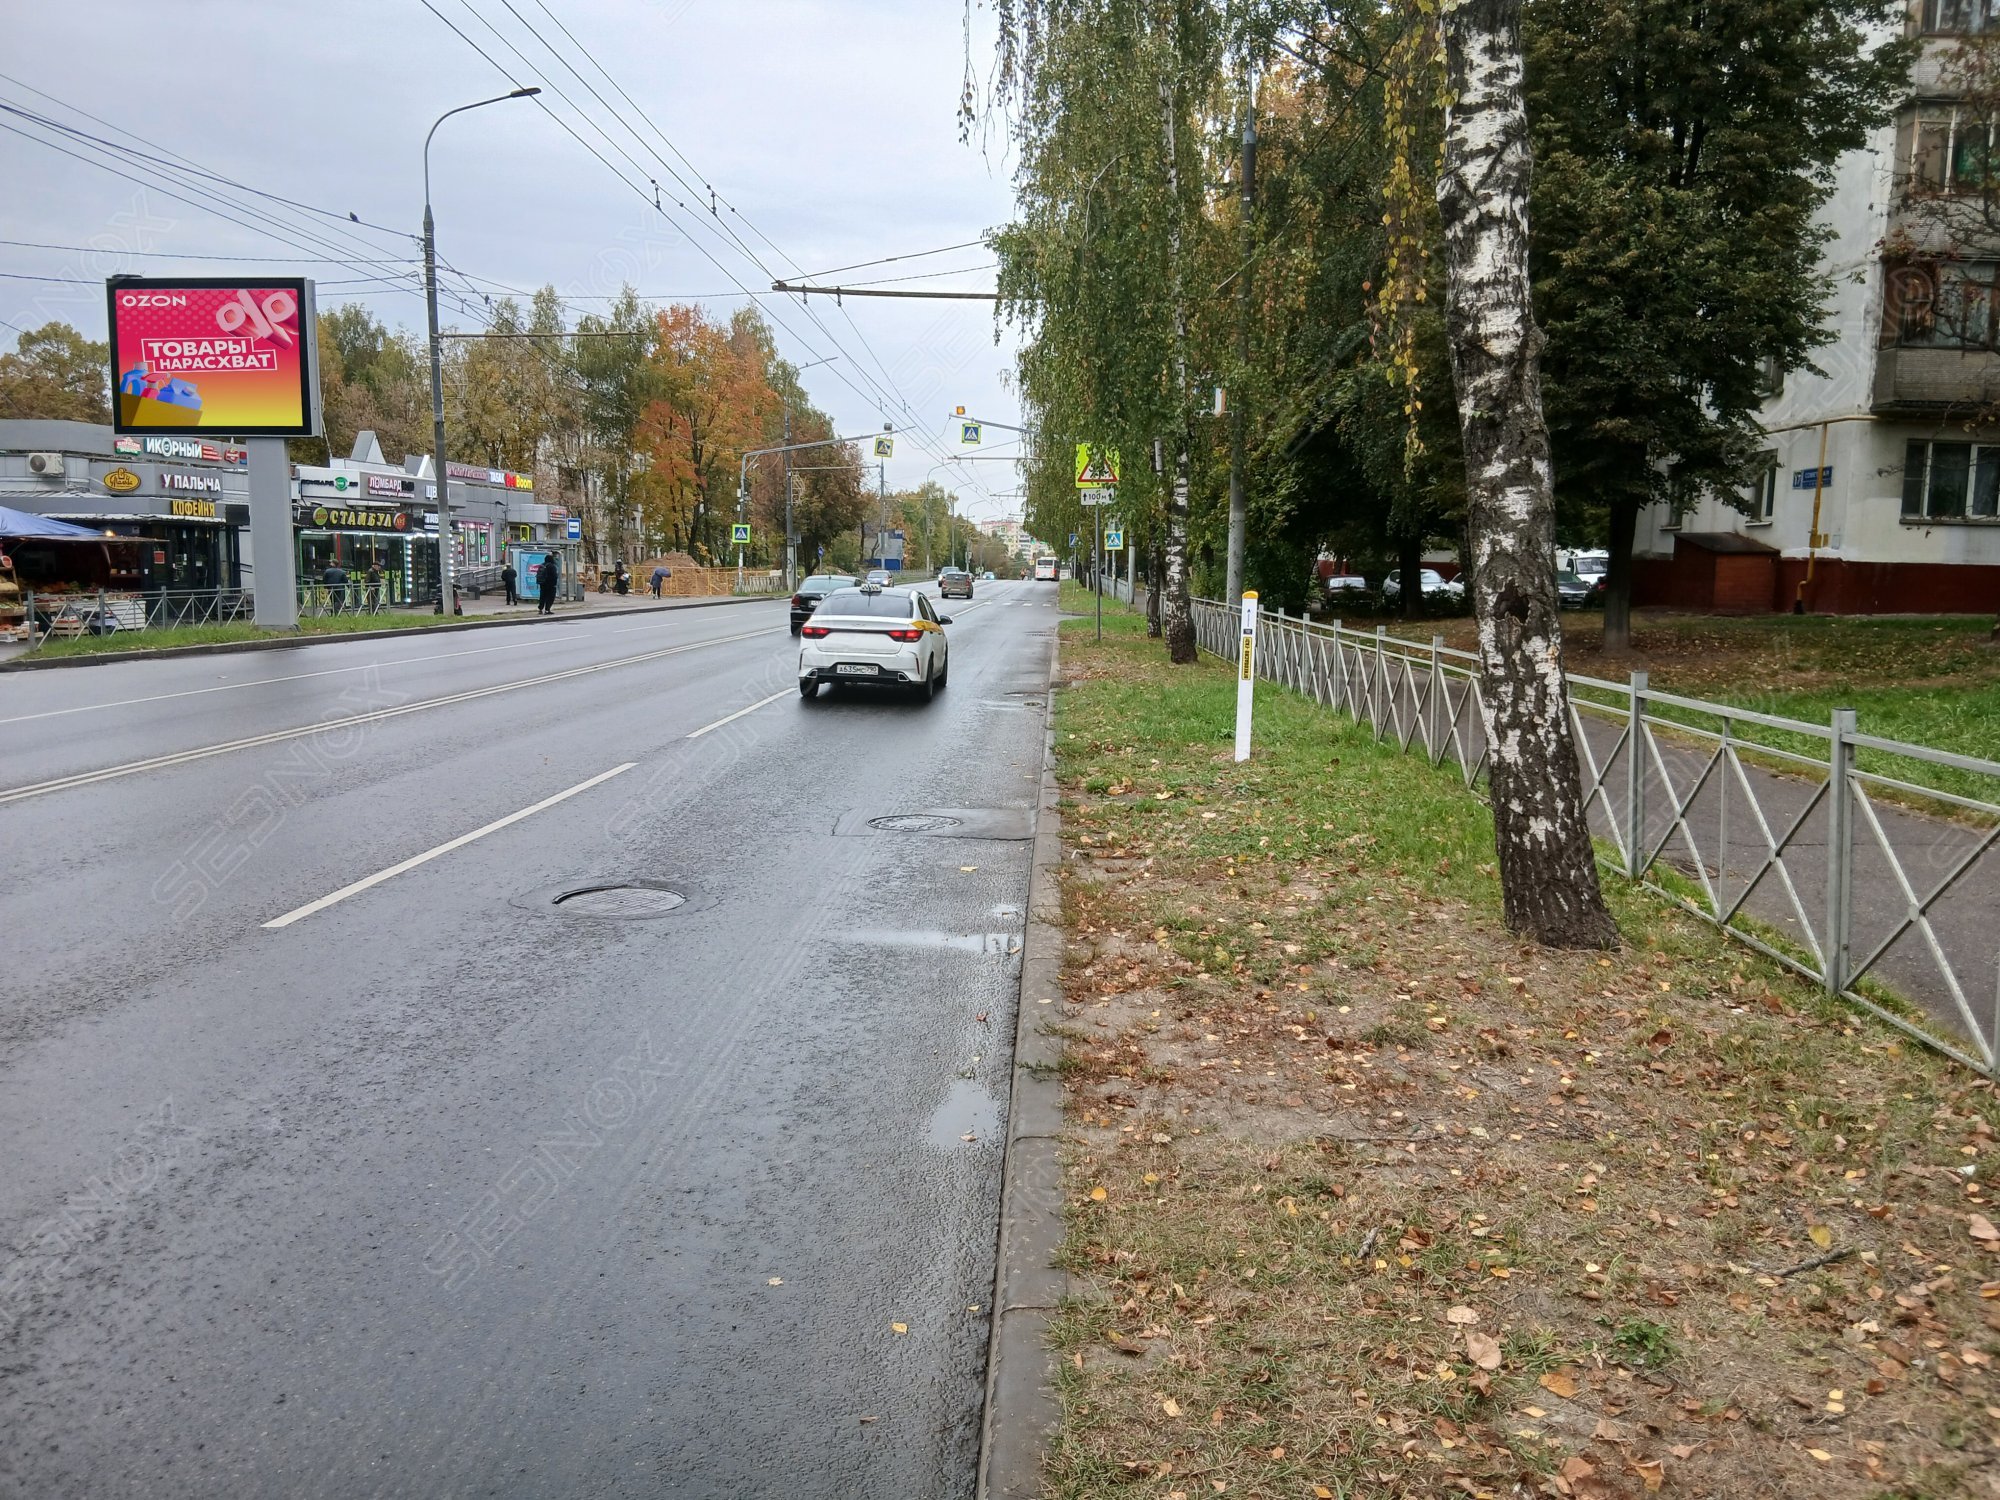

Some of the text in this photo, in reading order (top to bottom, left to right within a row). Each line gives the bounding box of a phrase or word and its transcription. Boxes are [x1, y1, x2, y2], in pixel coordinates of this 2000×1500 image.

[121, 295, 187, 307] OZON
[148, 340, 246, 358] ТОВАРЫ
[159, 354, 271, 370] НАРАСХВАТ
[146, 437, 203, 459] ИКОРНЫЙ
[162, 473, 221, 492] У ПАЛЫЧА
[369, 476, 402, 492] ЛОМБАРД
[172, 499, 215, 517] КОФЕЙНЯ
[330, 510, 392, 527] СТАМБУЛ
